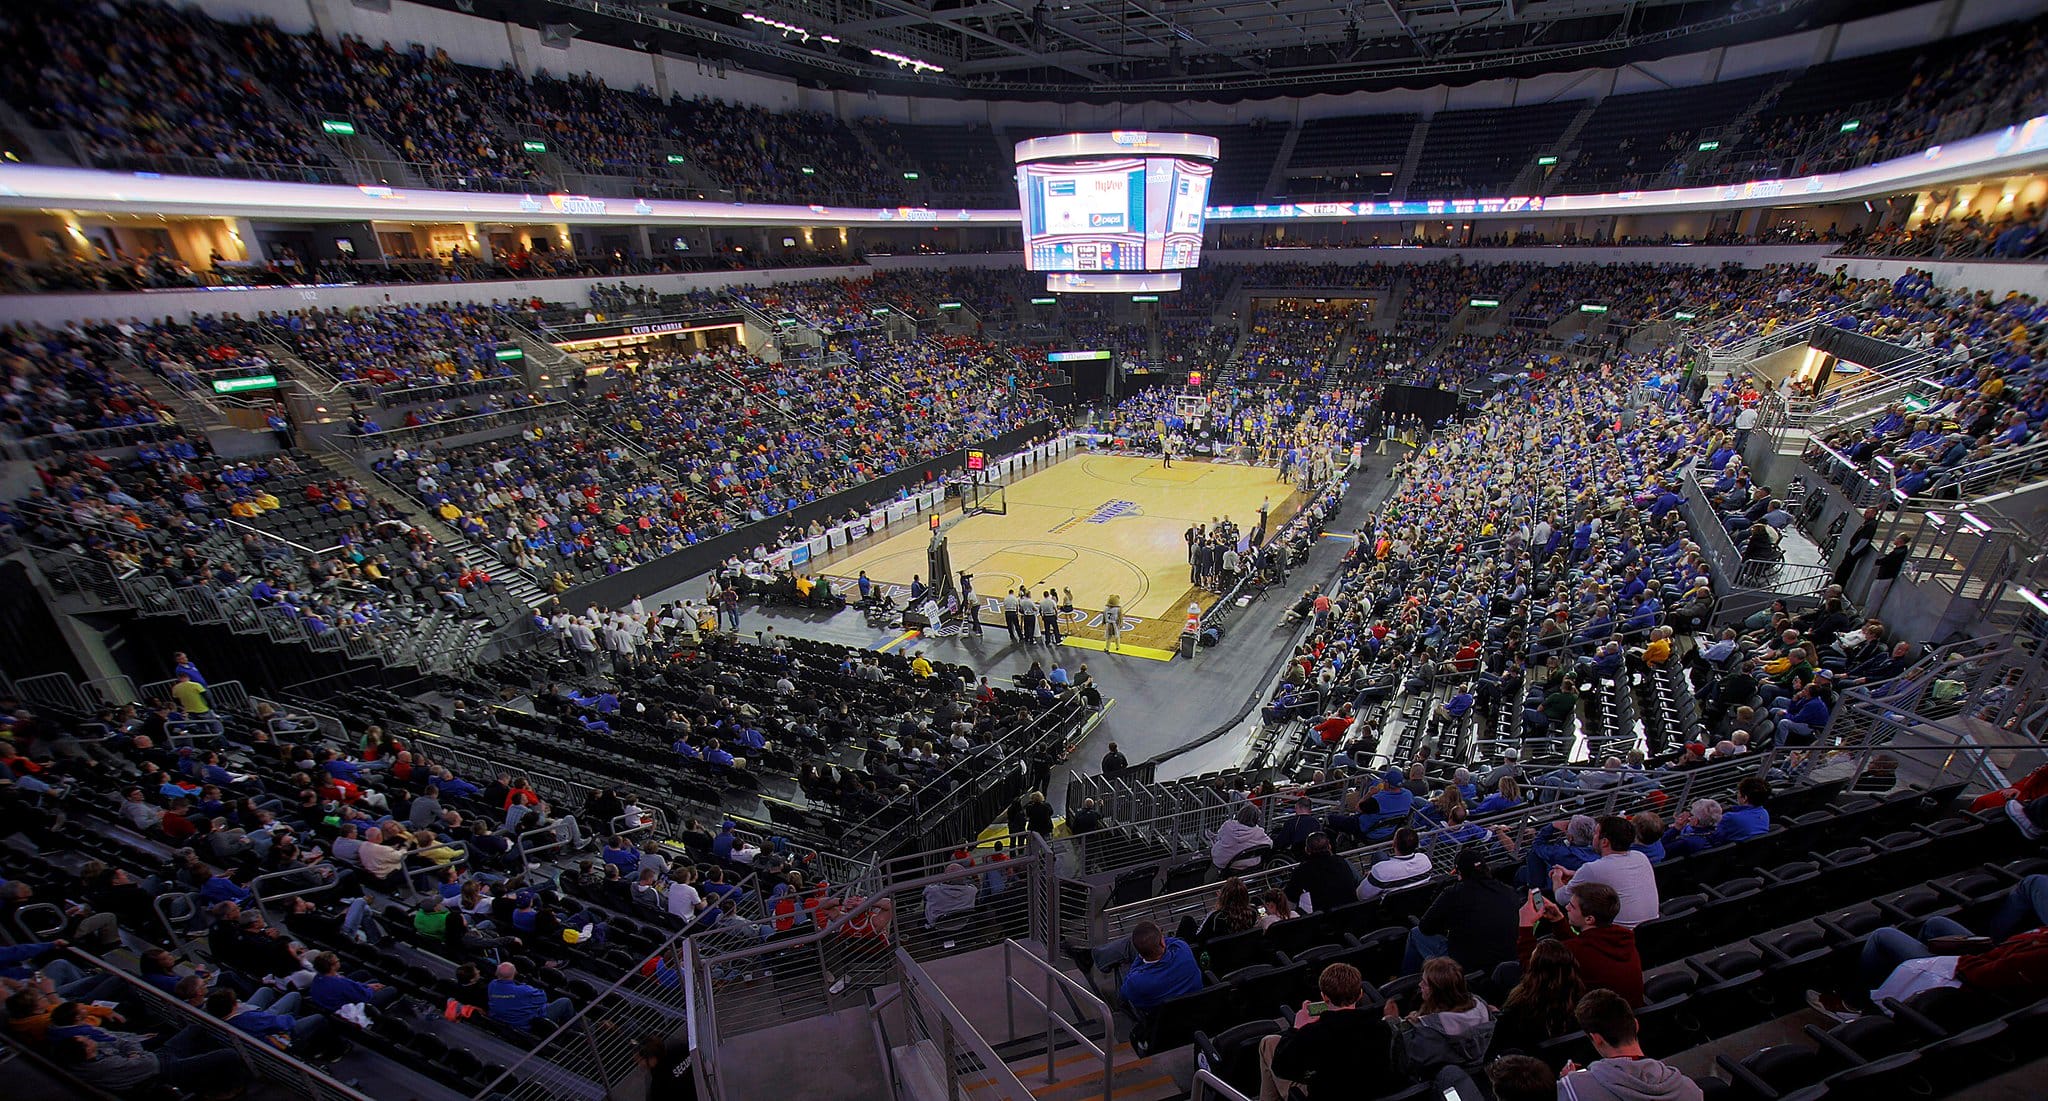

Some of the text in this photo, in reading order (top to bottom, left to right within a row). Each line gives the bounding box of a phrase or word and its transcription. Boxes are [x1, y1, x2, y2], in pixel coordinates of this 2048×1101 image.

[562, 199, 606, 214] SUMMIT
[1102, 214, 1121, 225] pepsi
[300, 291, 318, 300] 102
[632, 325, 650, 334] CLUB
[968, 457, 982, 469] 23
